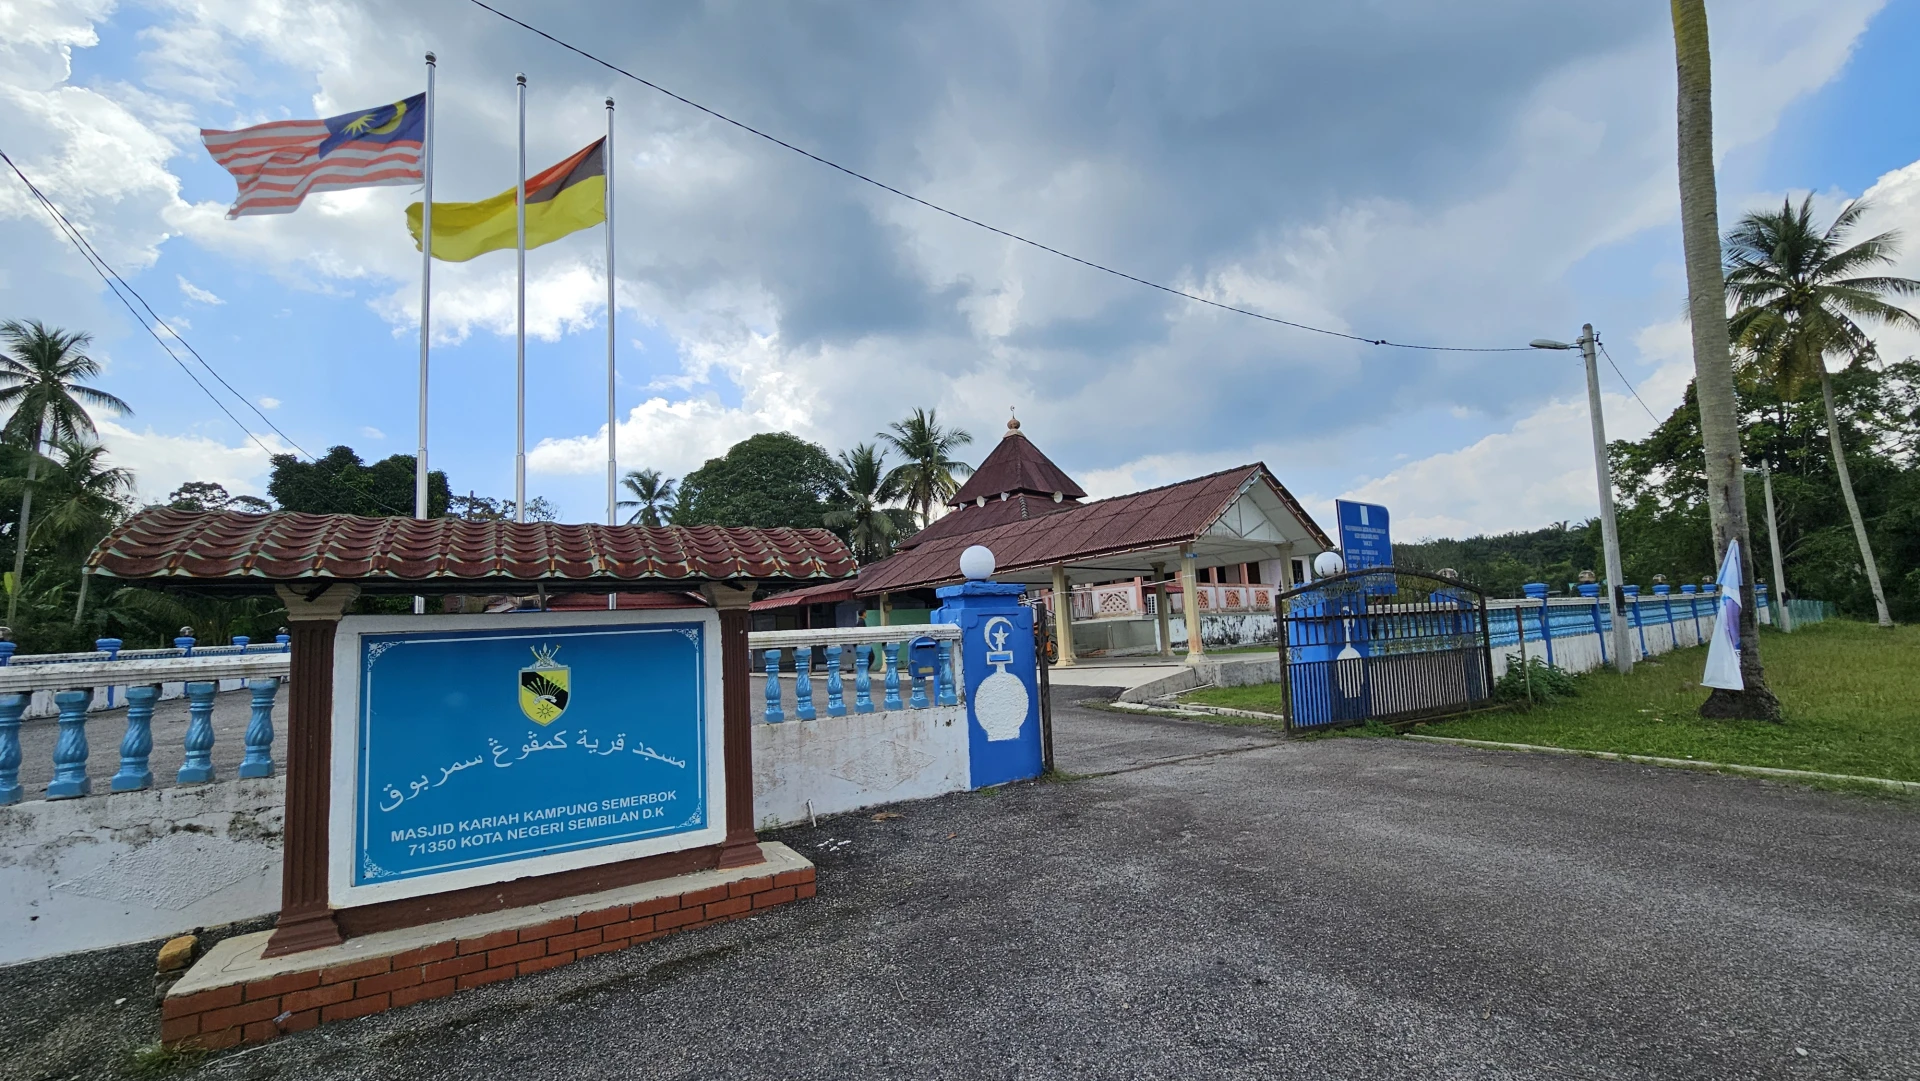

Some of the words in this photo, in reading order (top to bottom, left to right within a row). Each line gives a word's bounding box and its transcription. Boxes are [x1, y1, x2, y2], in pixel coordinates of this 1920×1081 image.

[576, 728, 627, 756] قرية
[632, 741, 686, 769] مسجد
[391, 822, 454, 842] MASJID
[458, 812, 519, 832] KARIAH
[523, 801, 598, 823] KAMPUNG
[601, 790, 677, 811] SEMERBOK
[408, 838, 457, 856] 71350
[460, 831, 503, 848] KOTA
[507, 821, 564, 841] NEGERI
[568, 811, 639, 831] SEMBILAN
[642, 806, 665, 820] D.K
